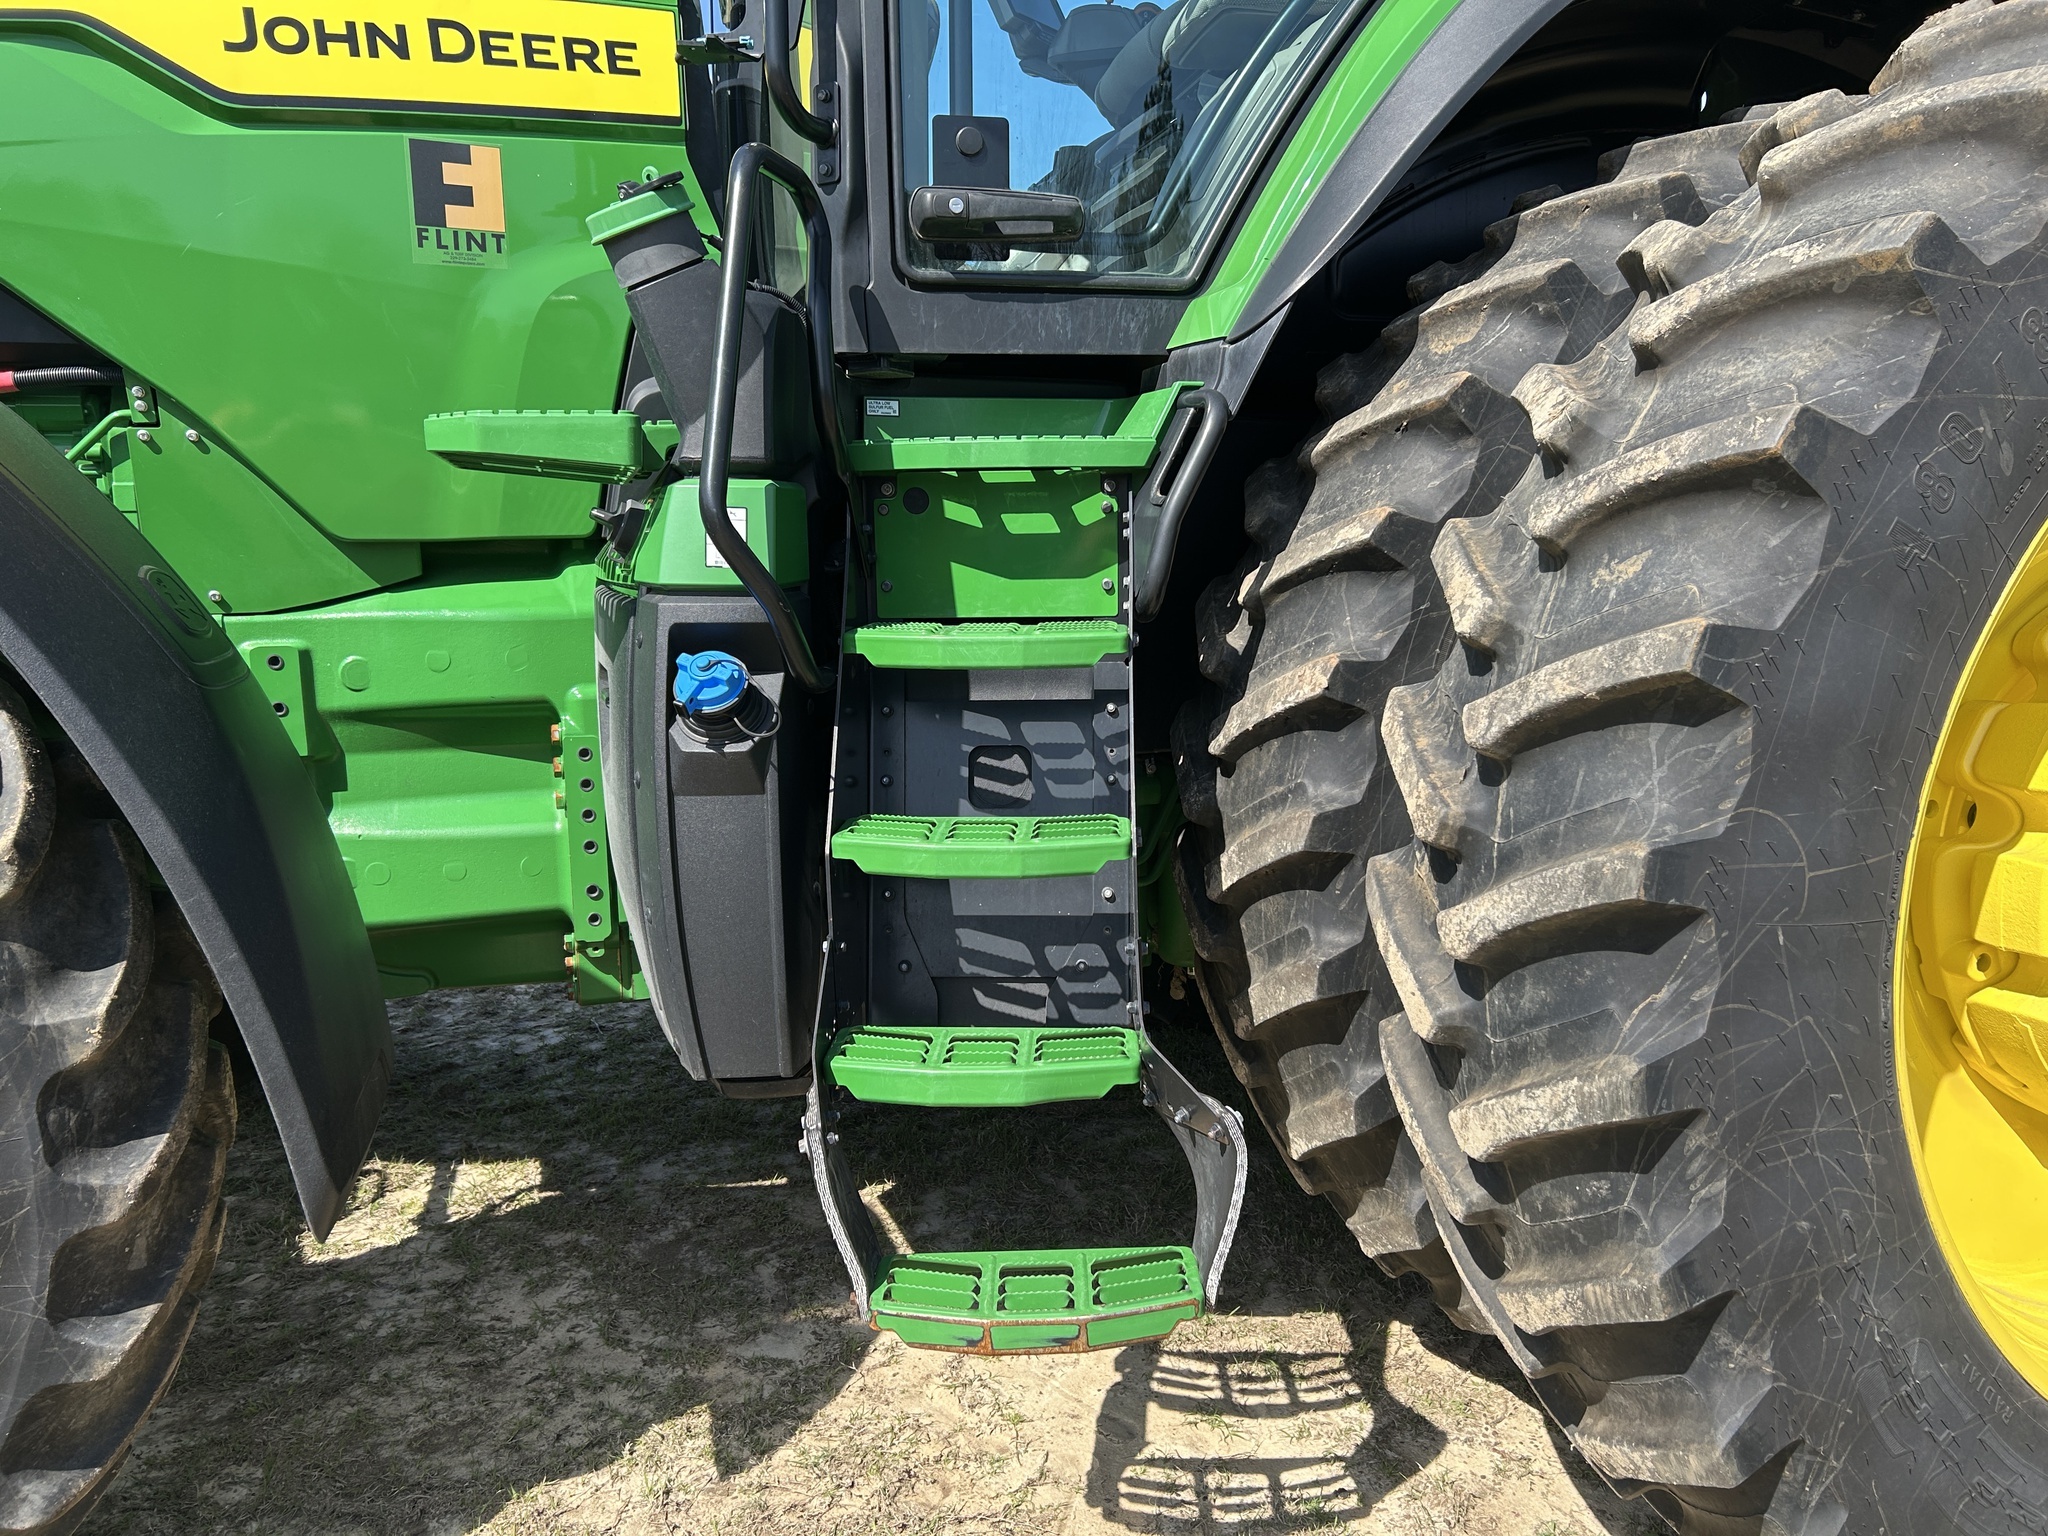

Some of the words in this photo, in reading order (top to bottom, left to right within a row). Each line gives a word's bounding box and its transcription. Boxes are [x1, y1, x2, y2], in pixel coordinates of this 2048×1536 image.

[223, 7, 411, 60] JOHN
[427, 18, 641, 76] DEERE
[416, 227, 506, 254] FLINT
[1961, 1353, 2014, 1425] RADIAL
